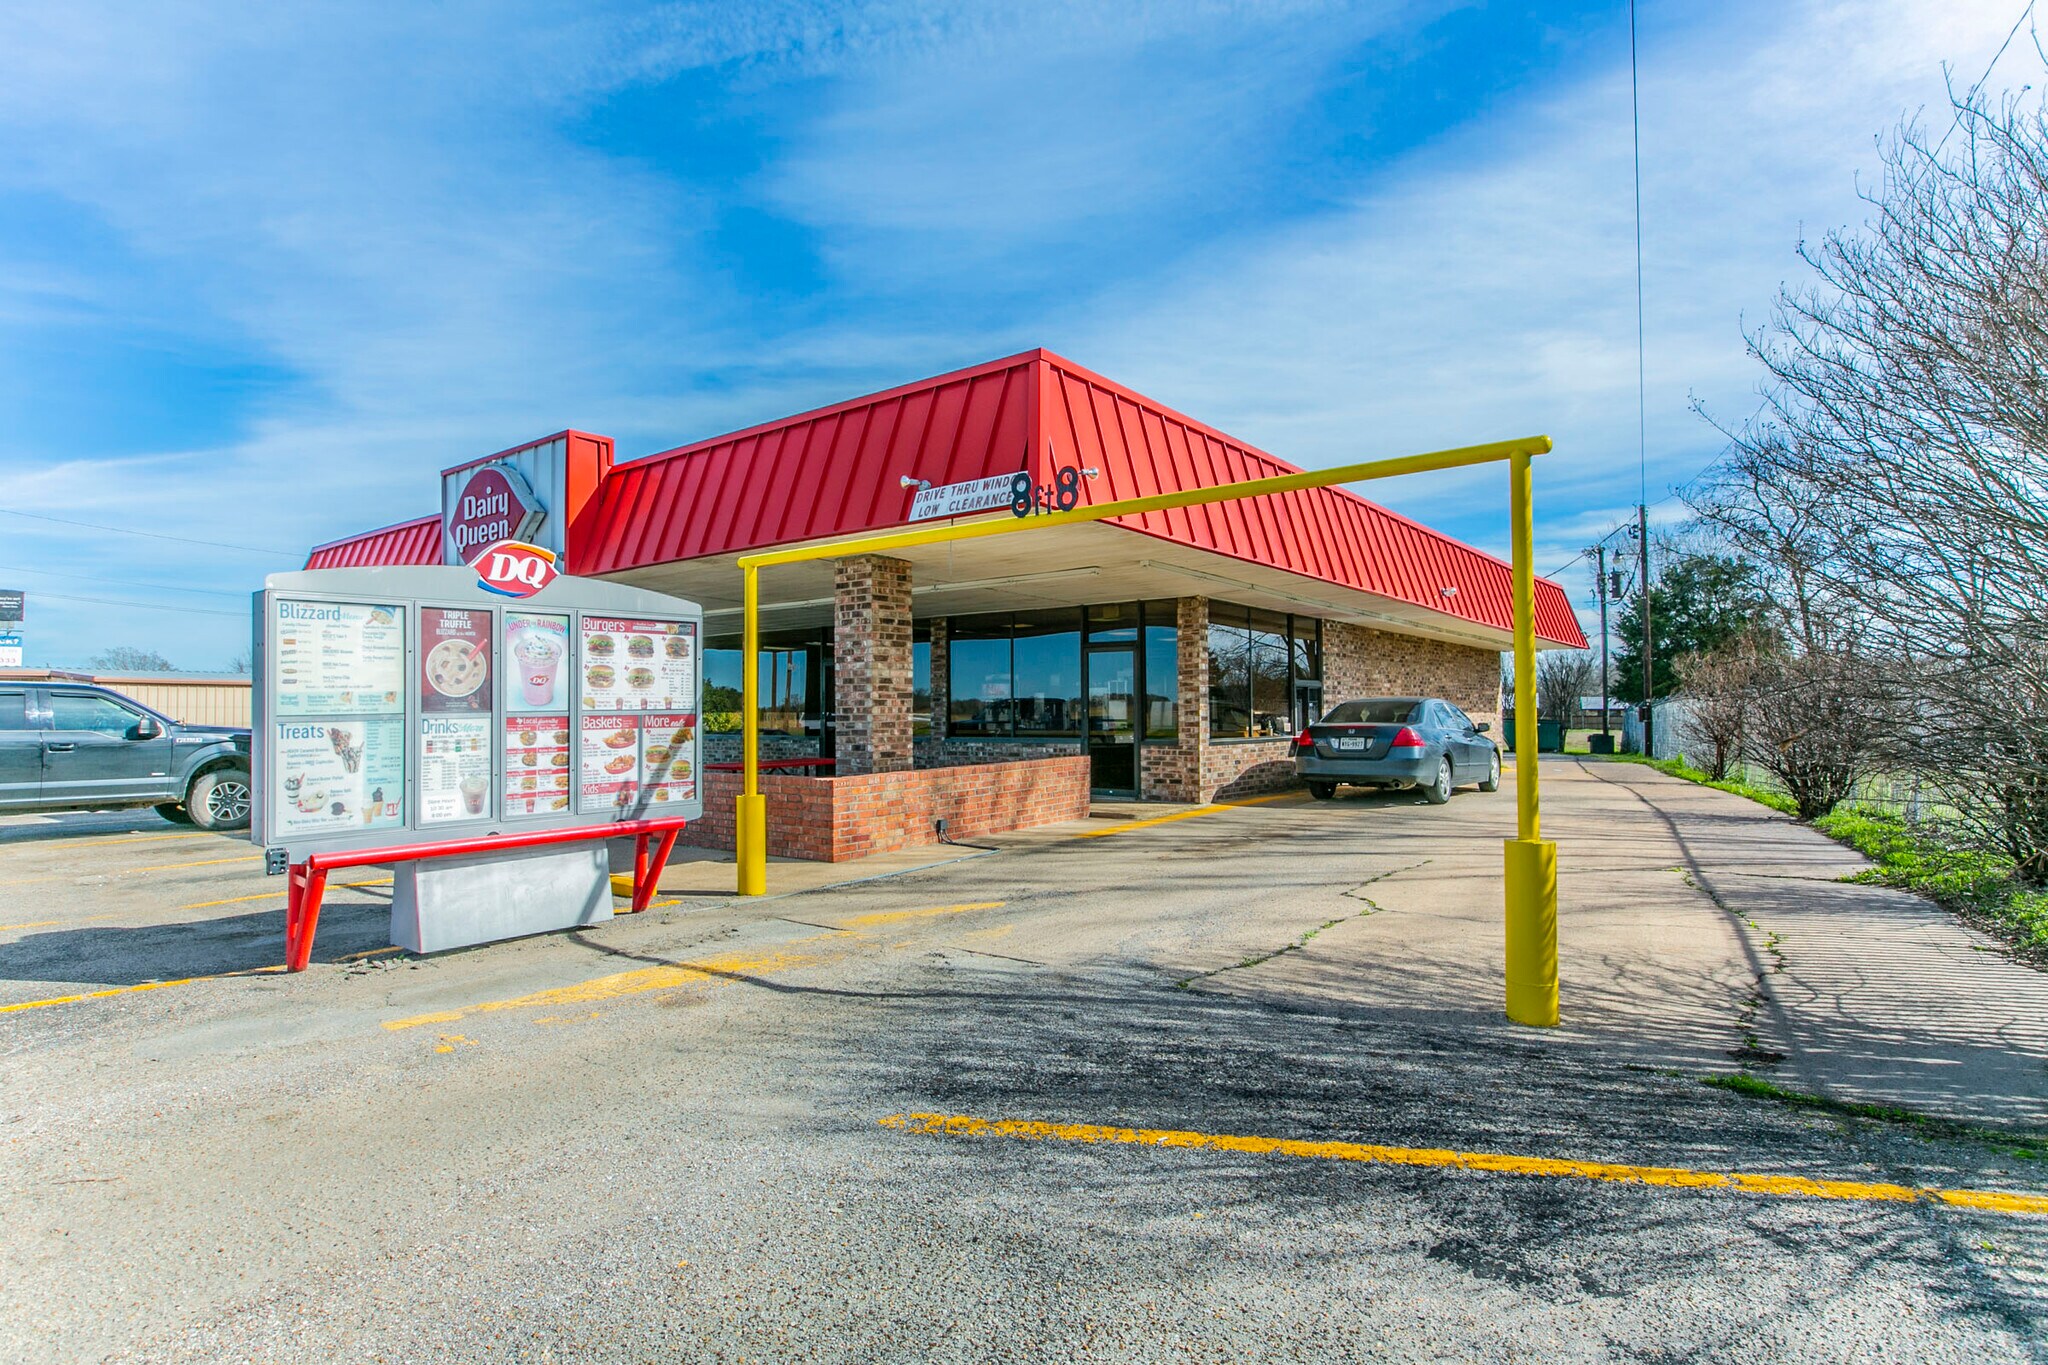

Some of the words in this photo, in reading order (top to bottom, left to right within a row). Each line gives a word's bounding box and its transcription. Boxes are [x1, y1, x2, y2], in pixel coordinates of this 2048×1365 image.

[916, 487, 945, 504] DRIVE
[951, 481, 979, 498] THRU
[464, 486, 509, 521] Dairy
[918, 503, 940, 519] LOW
[949, 491, 1012, 513] CLEARANCE
[456, 519, 509, 554] Queen
[488, 552, 547, 590] DQ
[280, 603, 340, 622] Blizzard
[443, 610, 469, 620] TRIPLE
[440, 619, 472, 629] TRUFFLE
[508, 619, 530, 631] UNDER
[537, 619, 566, 633] RAINBOW
[583, 617, 625, 634] Burgers
[422, 718, 458, 735] Drinks
[583, 716, 623, 729] Baskets
[645, 715, 670, 728] More
[278, 723, 325, 739] Treats
